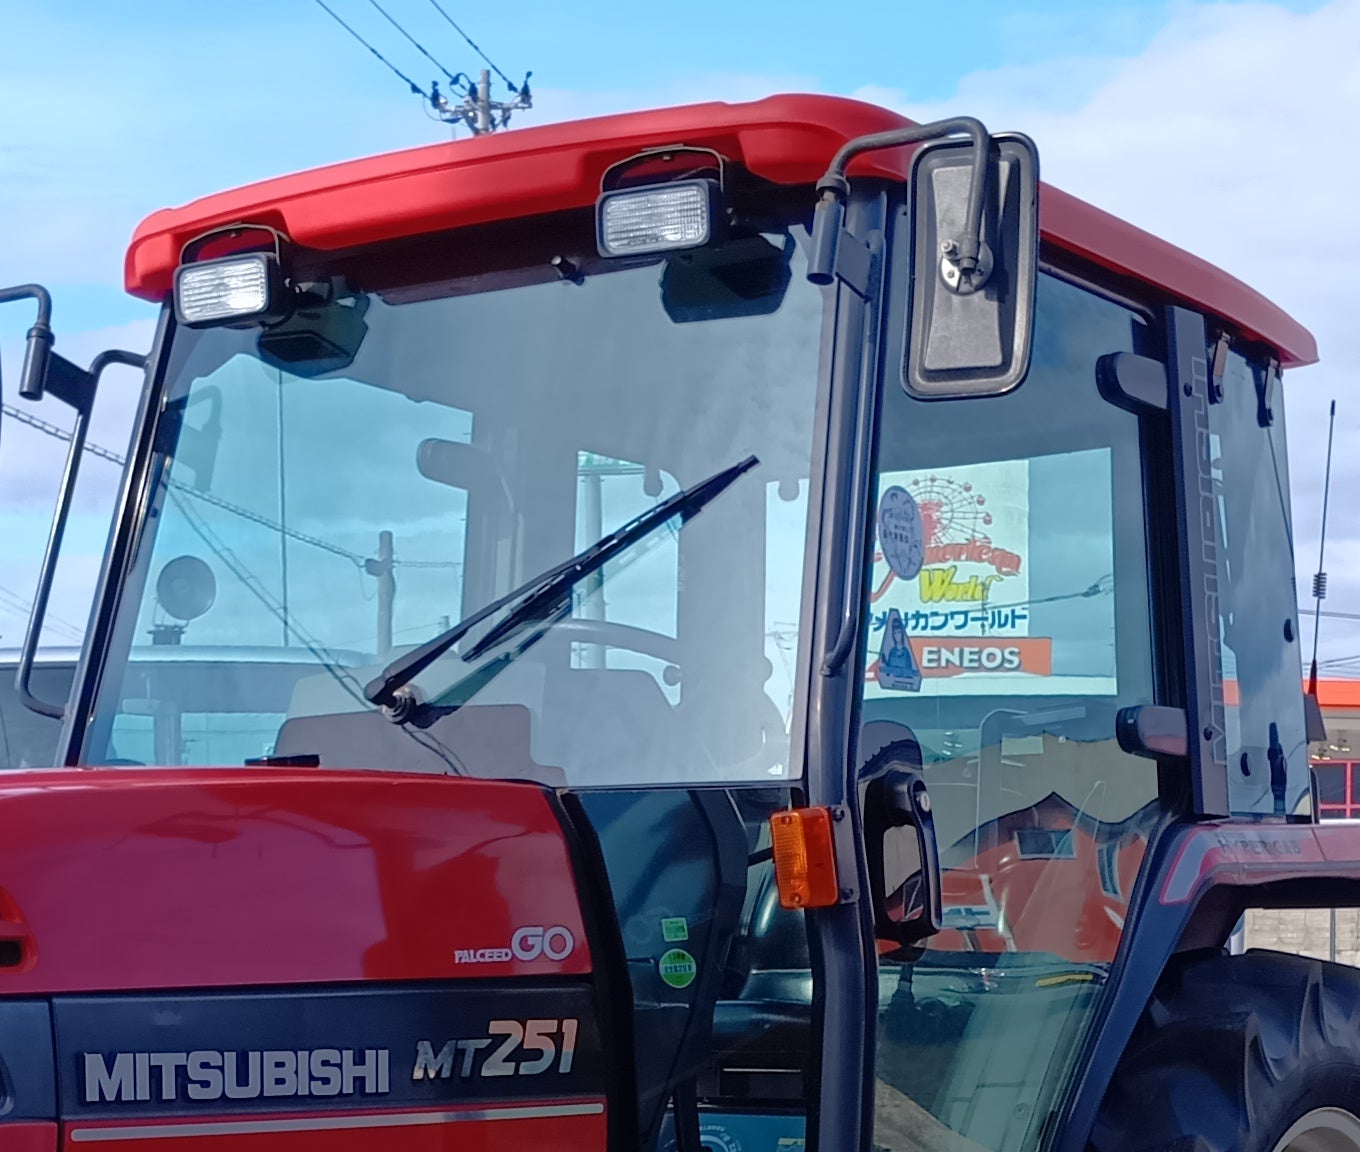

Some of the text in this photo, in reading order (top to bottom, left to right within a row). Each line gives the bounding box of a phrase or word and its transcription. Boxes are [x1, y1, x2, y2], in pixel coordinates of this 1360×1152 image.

[921, 646, 1021, 669] ENEOS
[454, 925, 574, 964] PALCEED GO
[83, 1018, 579, 1102] MITSUBISHI MT251
